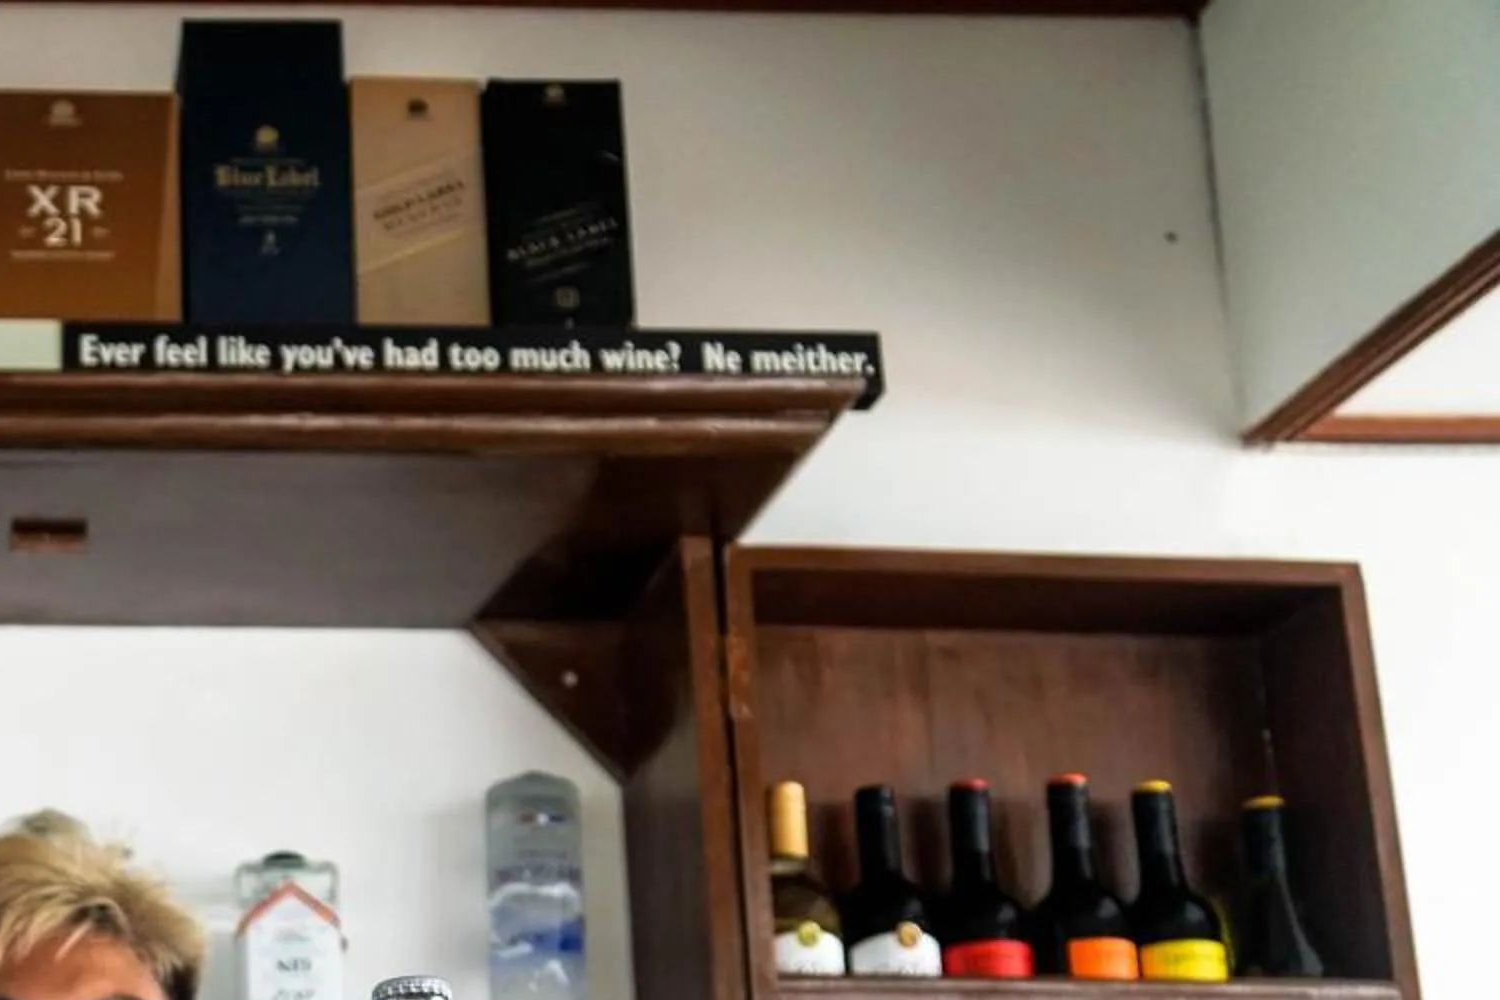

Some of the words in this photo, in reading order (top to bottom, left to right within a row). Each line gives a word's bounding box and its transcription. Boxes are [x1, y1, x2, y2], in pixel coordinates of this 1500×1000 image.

[26, 184, 103, 219] XR
[43, 217, 82, 247] 21
[79, 333, 145, 367] Ever
[154, 333, 208, 367] feel
[216, 334, 271, 367] like
[281, 336, 375, 375] you've
[383, 336, 439, 371] had
[448, 341, 501, 371] too
[509, 339, 591, 372] much
[600, 340, 681, 372] wine?
[701, 341, 742, 374] Ne
[750, 343, 875, 376] meither.
